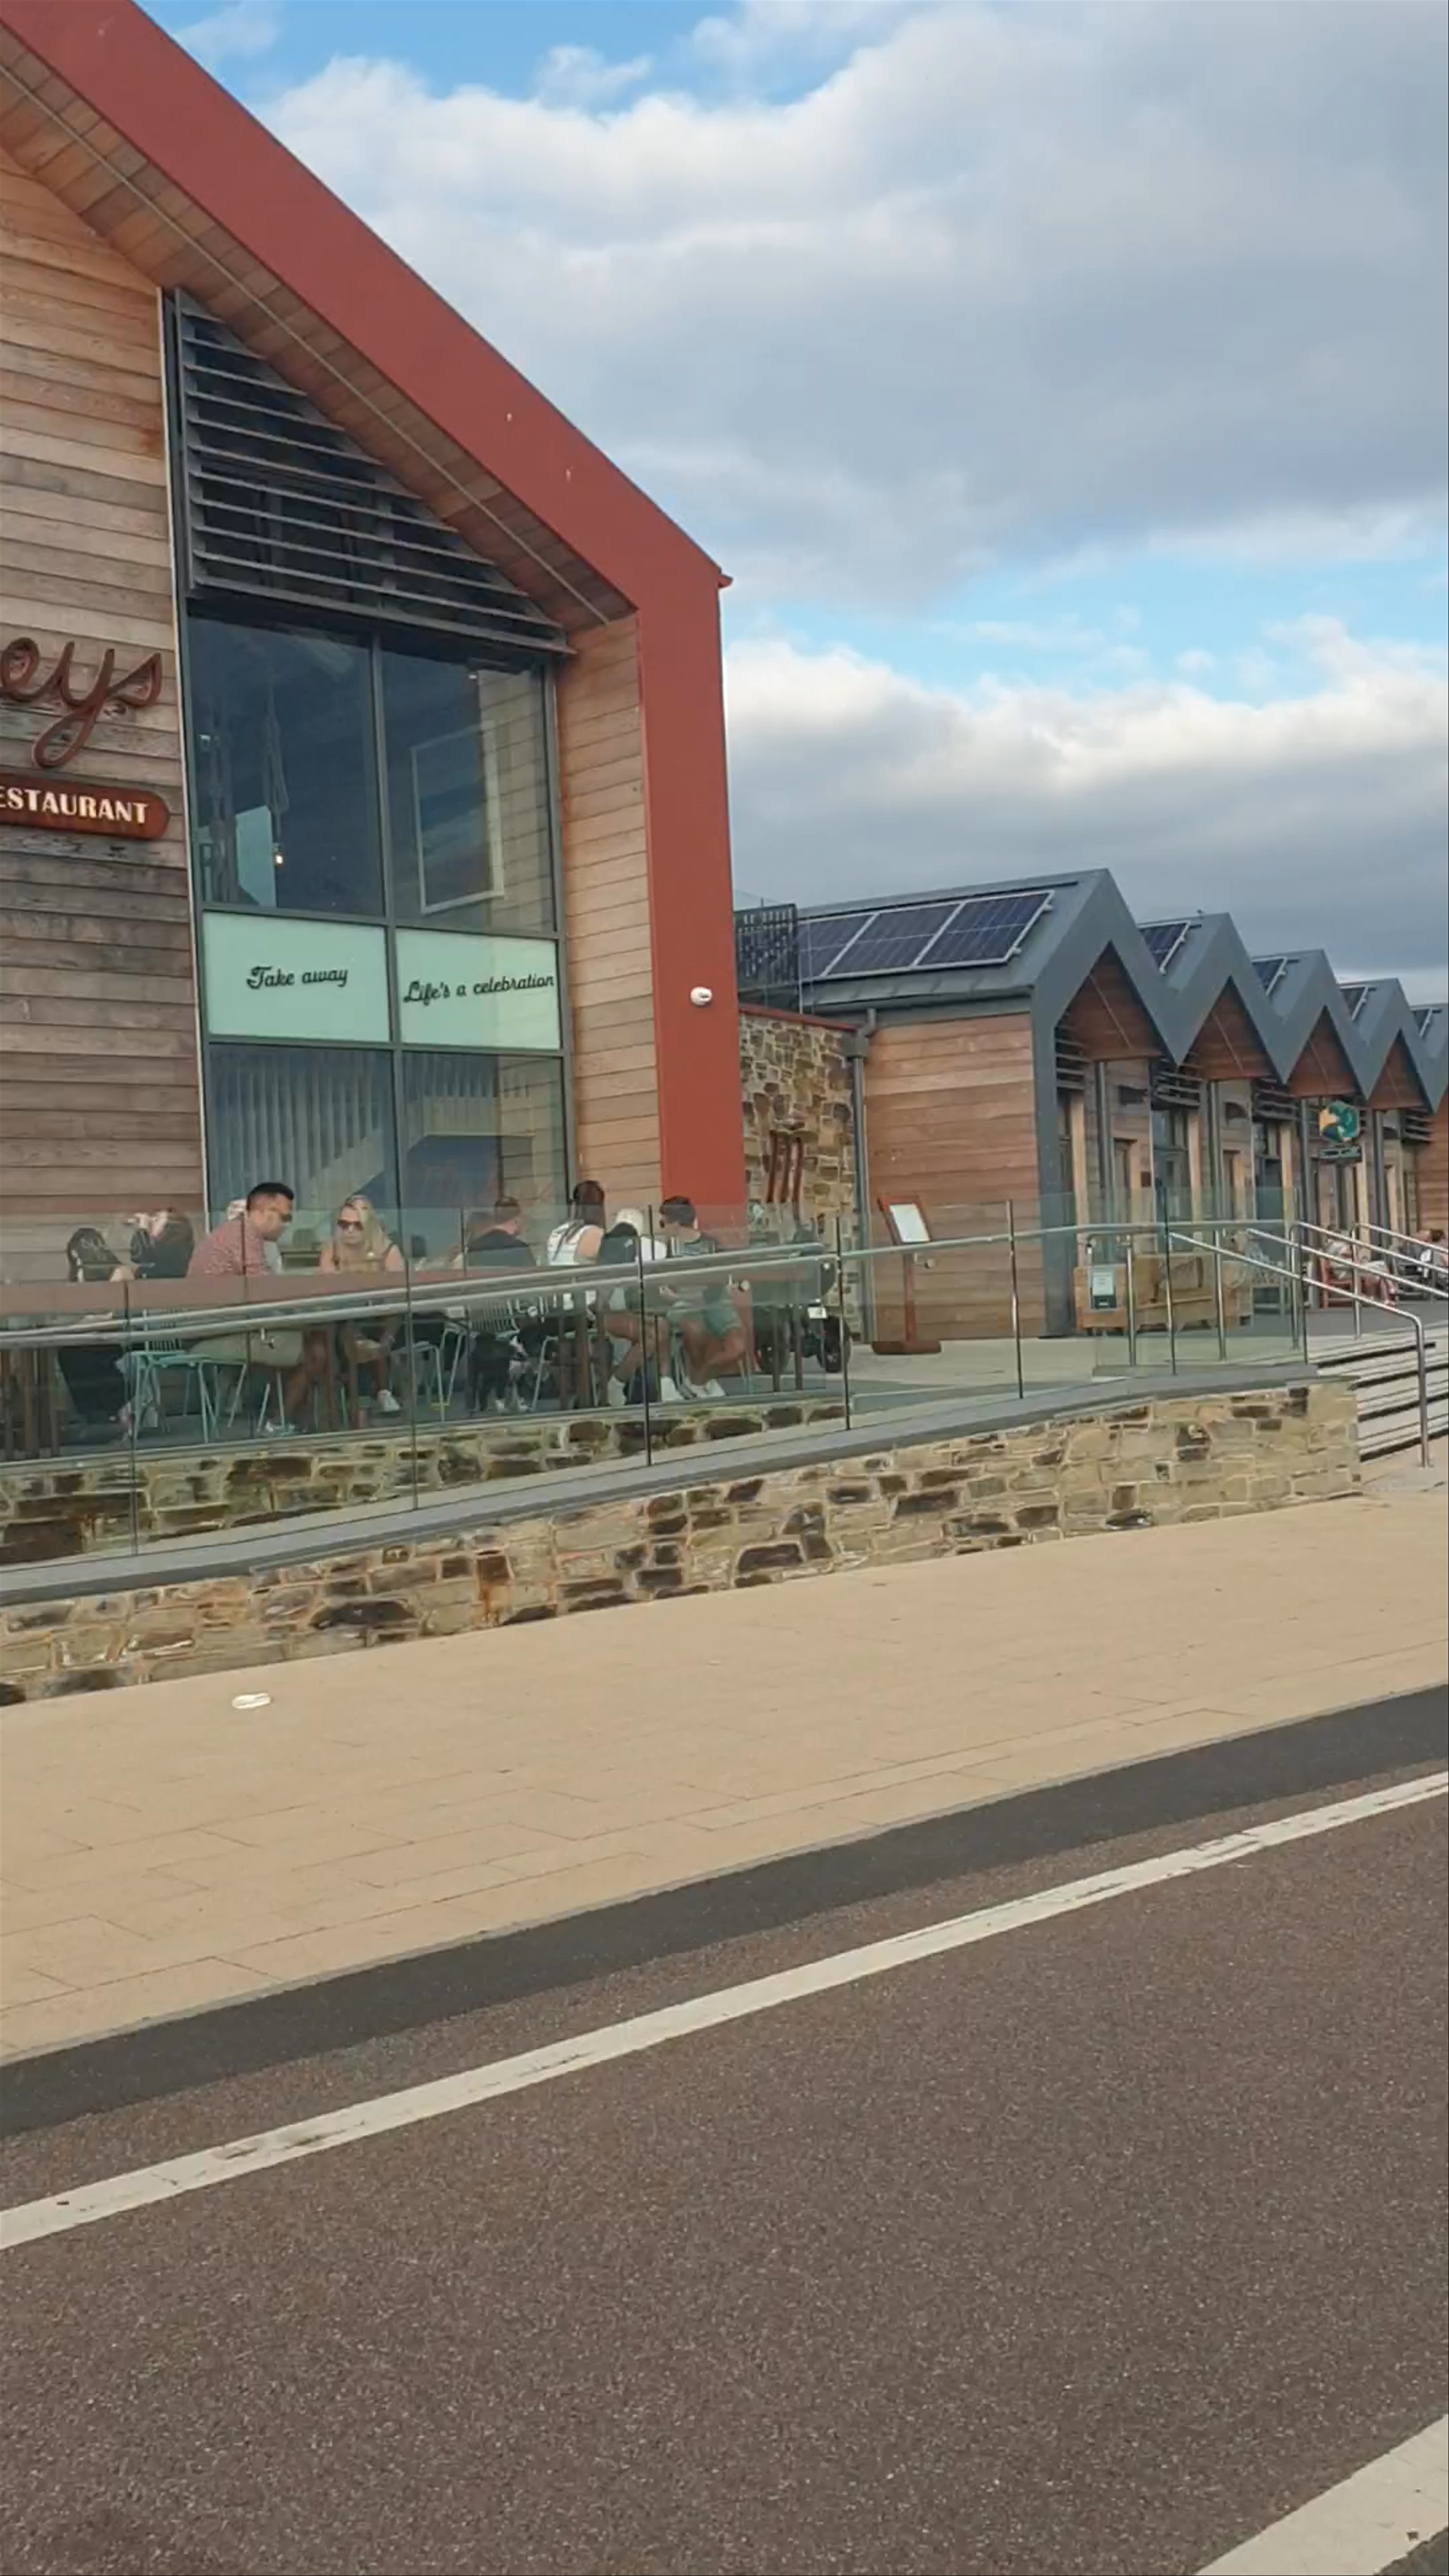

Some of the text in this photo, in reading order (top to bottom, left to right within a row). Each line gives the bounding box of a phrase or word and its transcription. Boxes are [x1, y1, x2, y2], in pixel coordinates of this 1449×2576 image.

[246, 965, 348, 989] Take away
[403, 974, 554, 1006] Life's a celebration
